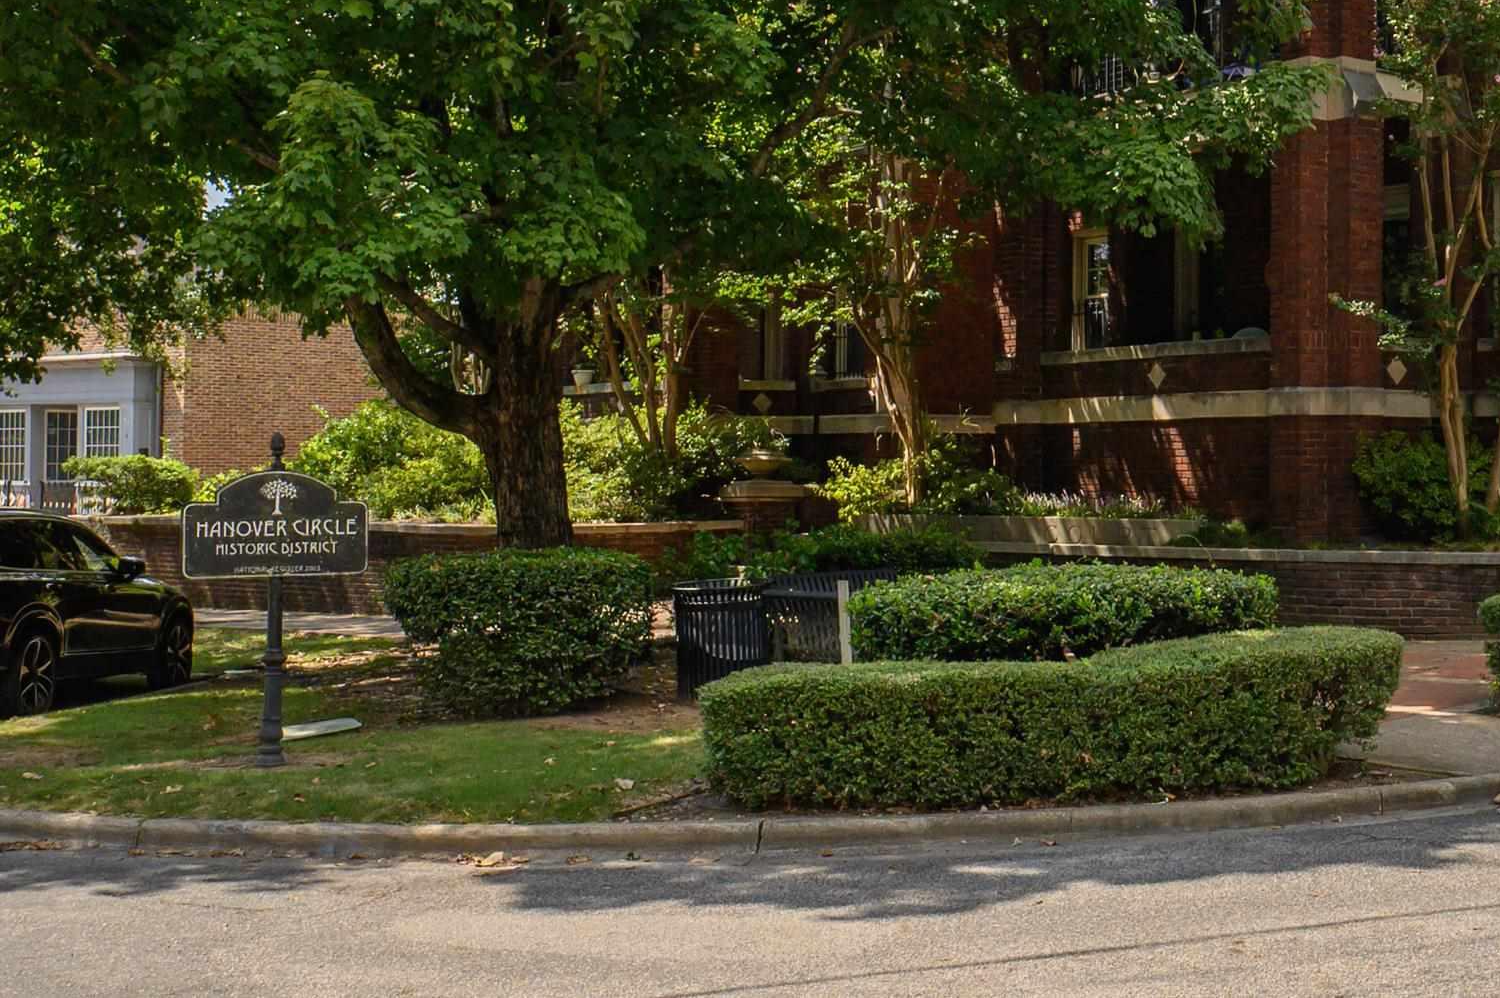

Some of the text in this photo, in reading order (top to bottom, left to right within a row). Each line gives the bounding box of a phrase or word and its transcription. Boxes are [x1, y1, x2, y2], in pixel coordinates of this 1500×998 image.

[196, 518, 357, 538] HANOVER CIRCLE
[215, 540, 337, 556] HISTORIC DISTRICT
